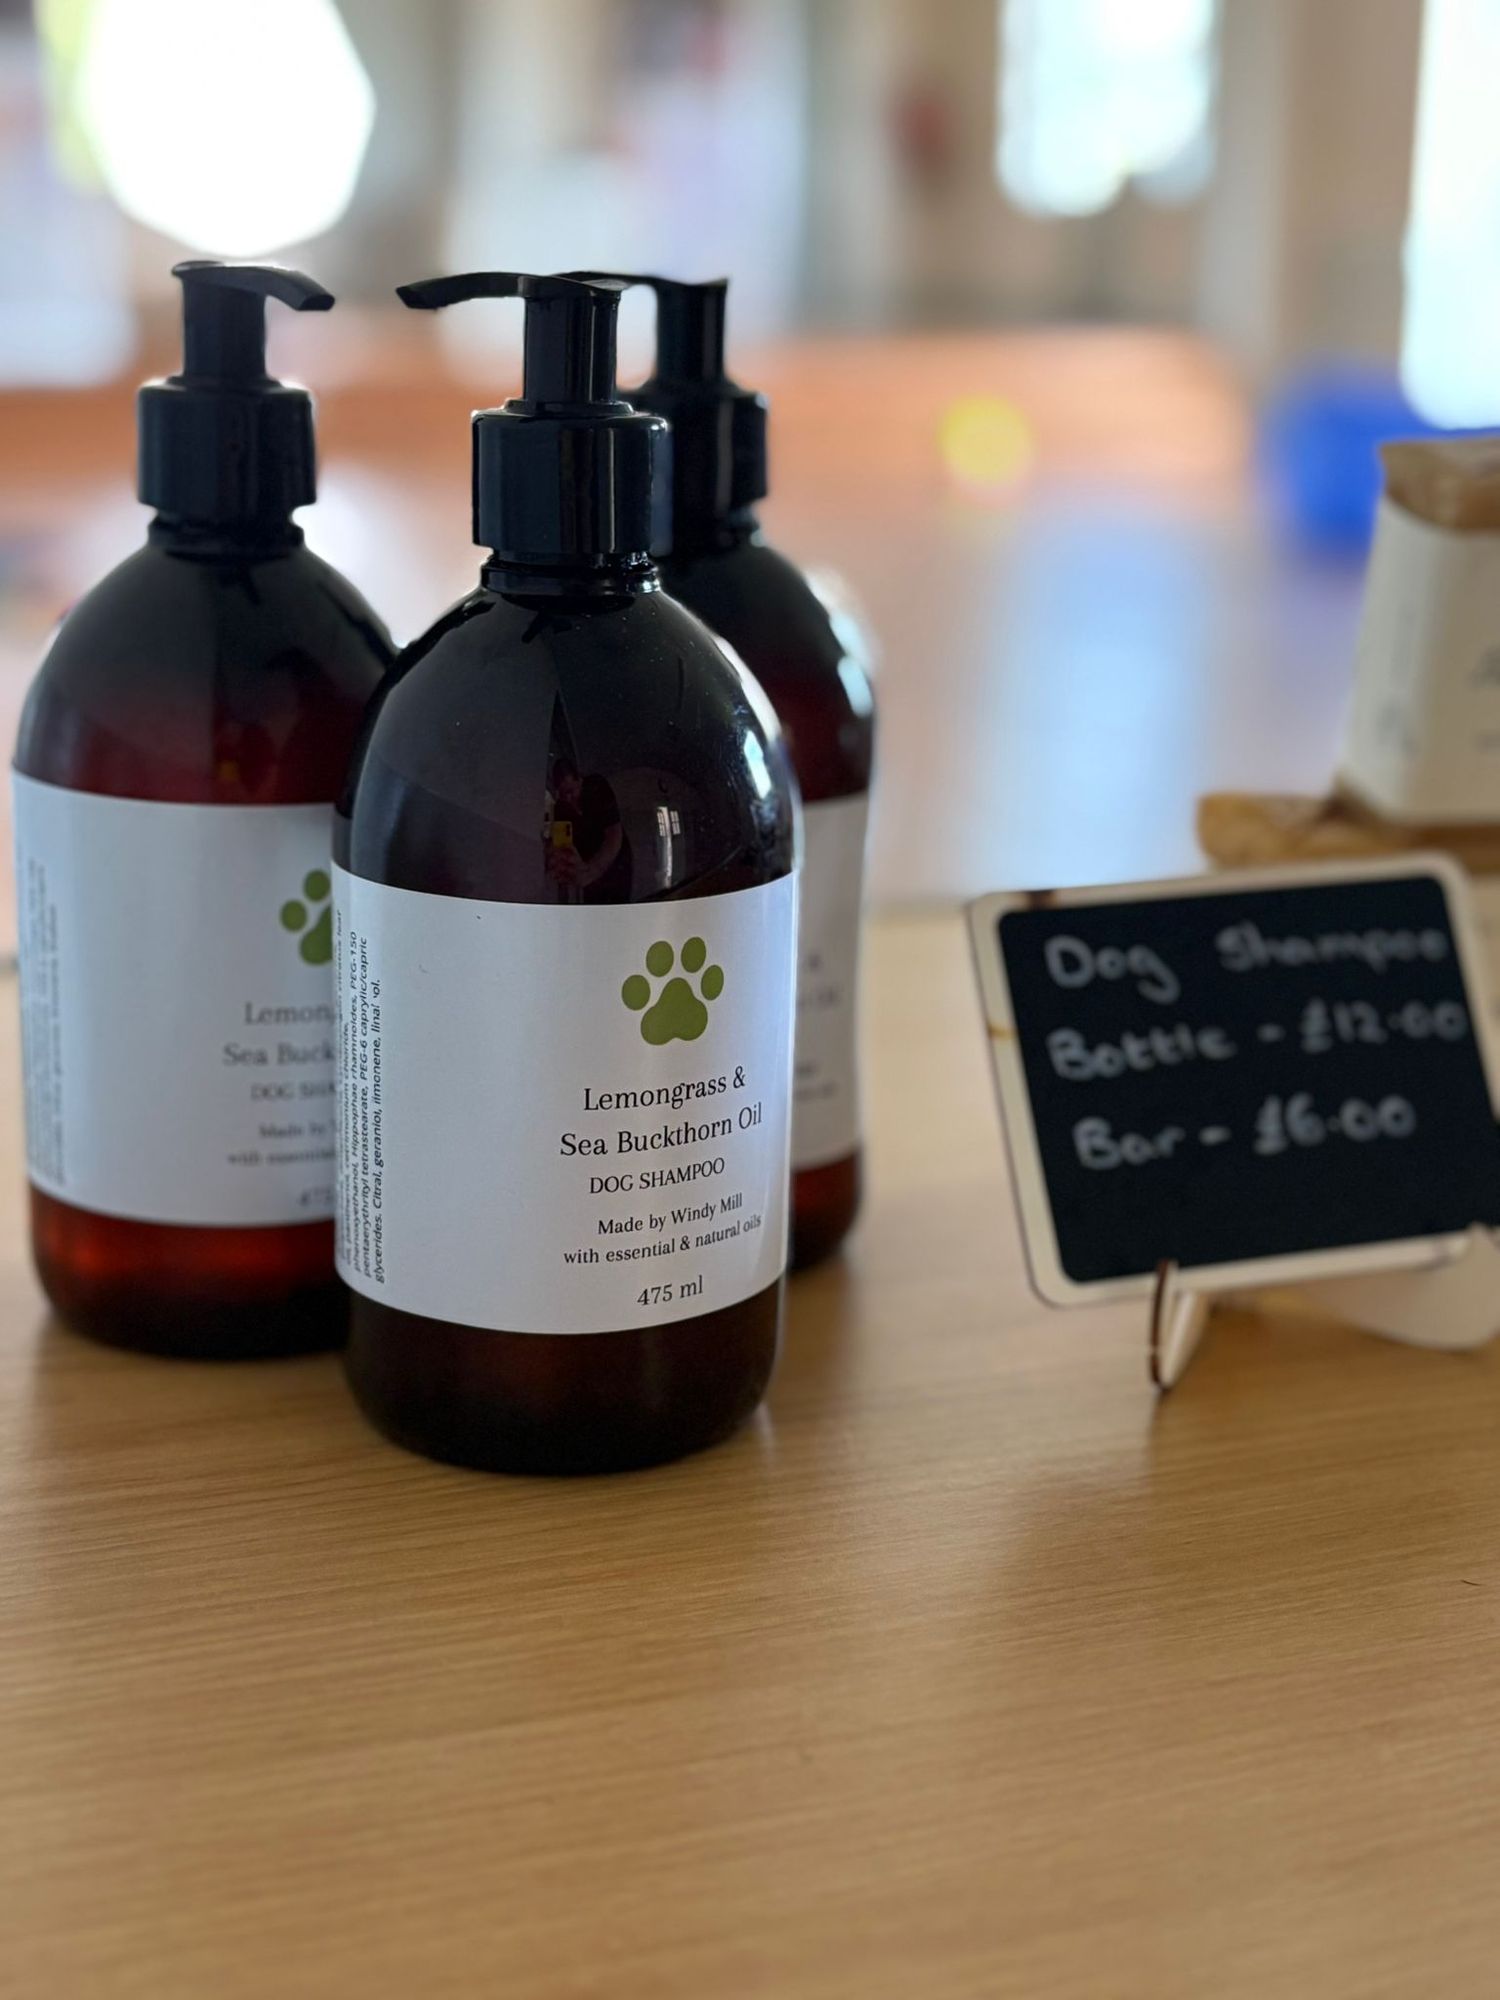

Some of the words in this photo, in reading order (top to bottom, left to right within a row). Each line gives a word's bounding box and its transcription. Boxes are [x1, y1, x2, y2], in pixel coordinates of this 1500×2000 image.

[1044, 934, 1181, 1005] Dog
[1214, 920, 1450, 974] Shampoo
[359, 936, 370, 1037] caprylic/capric
[370, 979, 381, 1033] linalol.
[244, 1001, 336, 1026] Lemon
[222, 1042, 269, 1067] Sea
[359, 1040, 368, 1081] PEG-6
[1045, 1023, 1237, 1081] Bottle
[583, 1075, 727, 1111] Lemongrass
[732, 1065, 747, 1089] &
[559, 1132, 608, 1156] Sea
[616, 1117, 732, 1154] Buckthorn
[738, 1101, 763, 1130] Oil
[1072, 1117, 1185, 1170] Bar
[372, 1171, 383, 1209] Citral,
[589, 1174, 634, 1194] DOG
[638, 1157, 726, 1190] SHAMPOO
[597, 1216, 643, 1235] Made
[648, 1213, 667, 1232] by
[671, 1201, 717, 1225] Windy
[720, 1192, 743, 1214] Mill
[563, 1248, 600, 1264] with
[605, 1238, 675, 1262] essential
[679, 1235, 691, 1251] &
[695, 1220, 741, 1248] natural
[742, 1213, 762, 1233] oils
[636, 1283, 673, 1306] 475
[679, 1274, 704, 1299] ml
